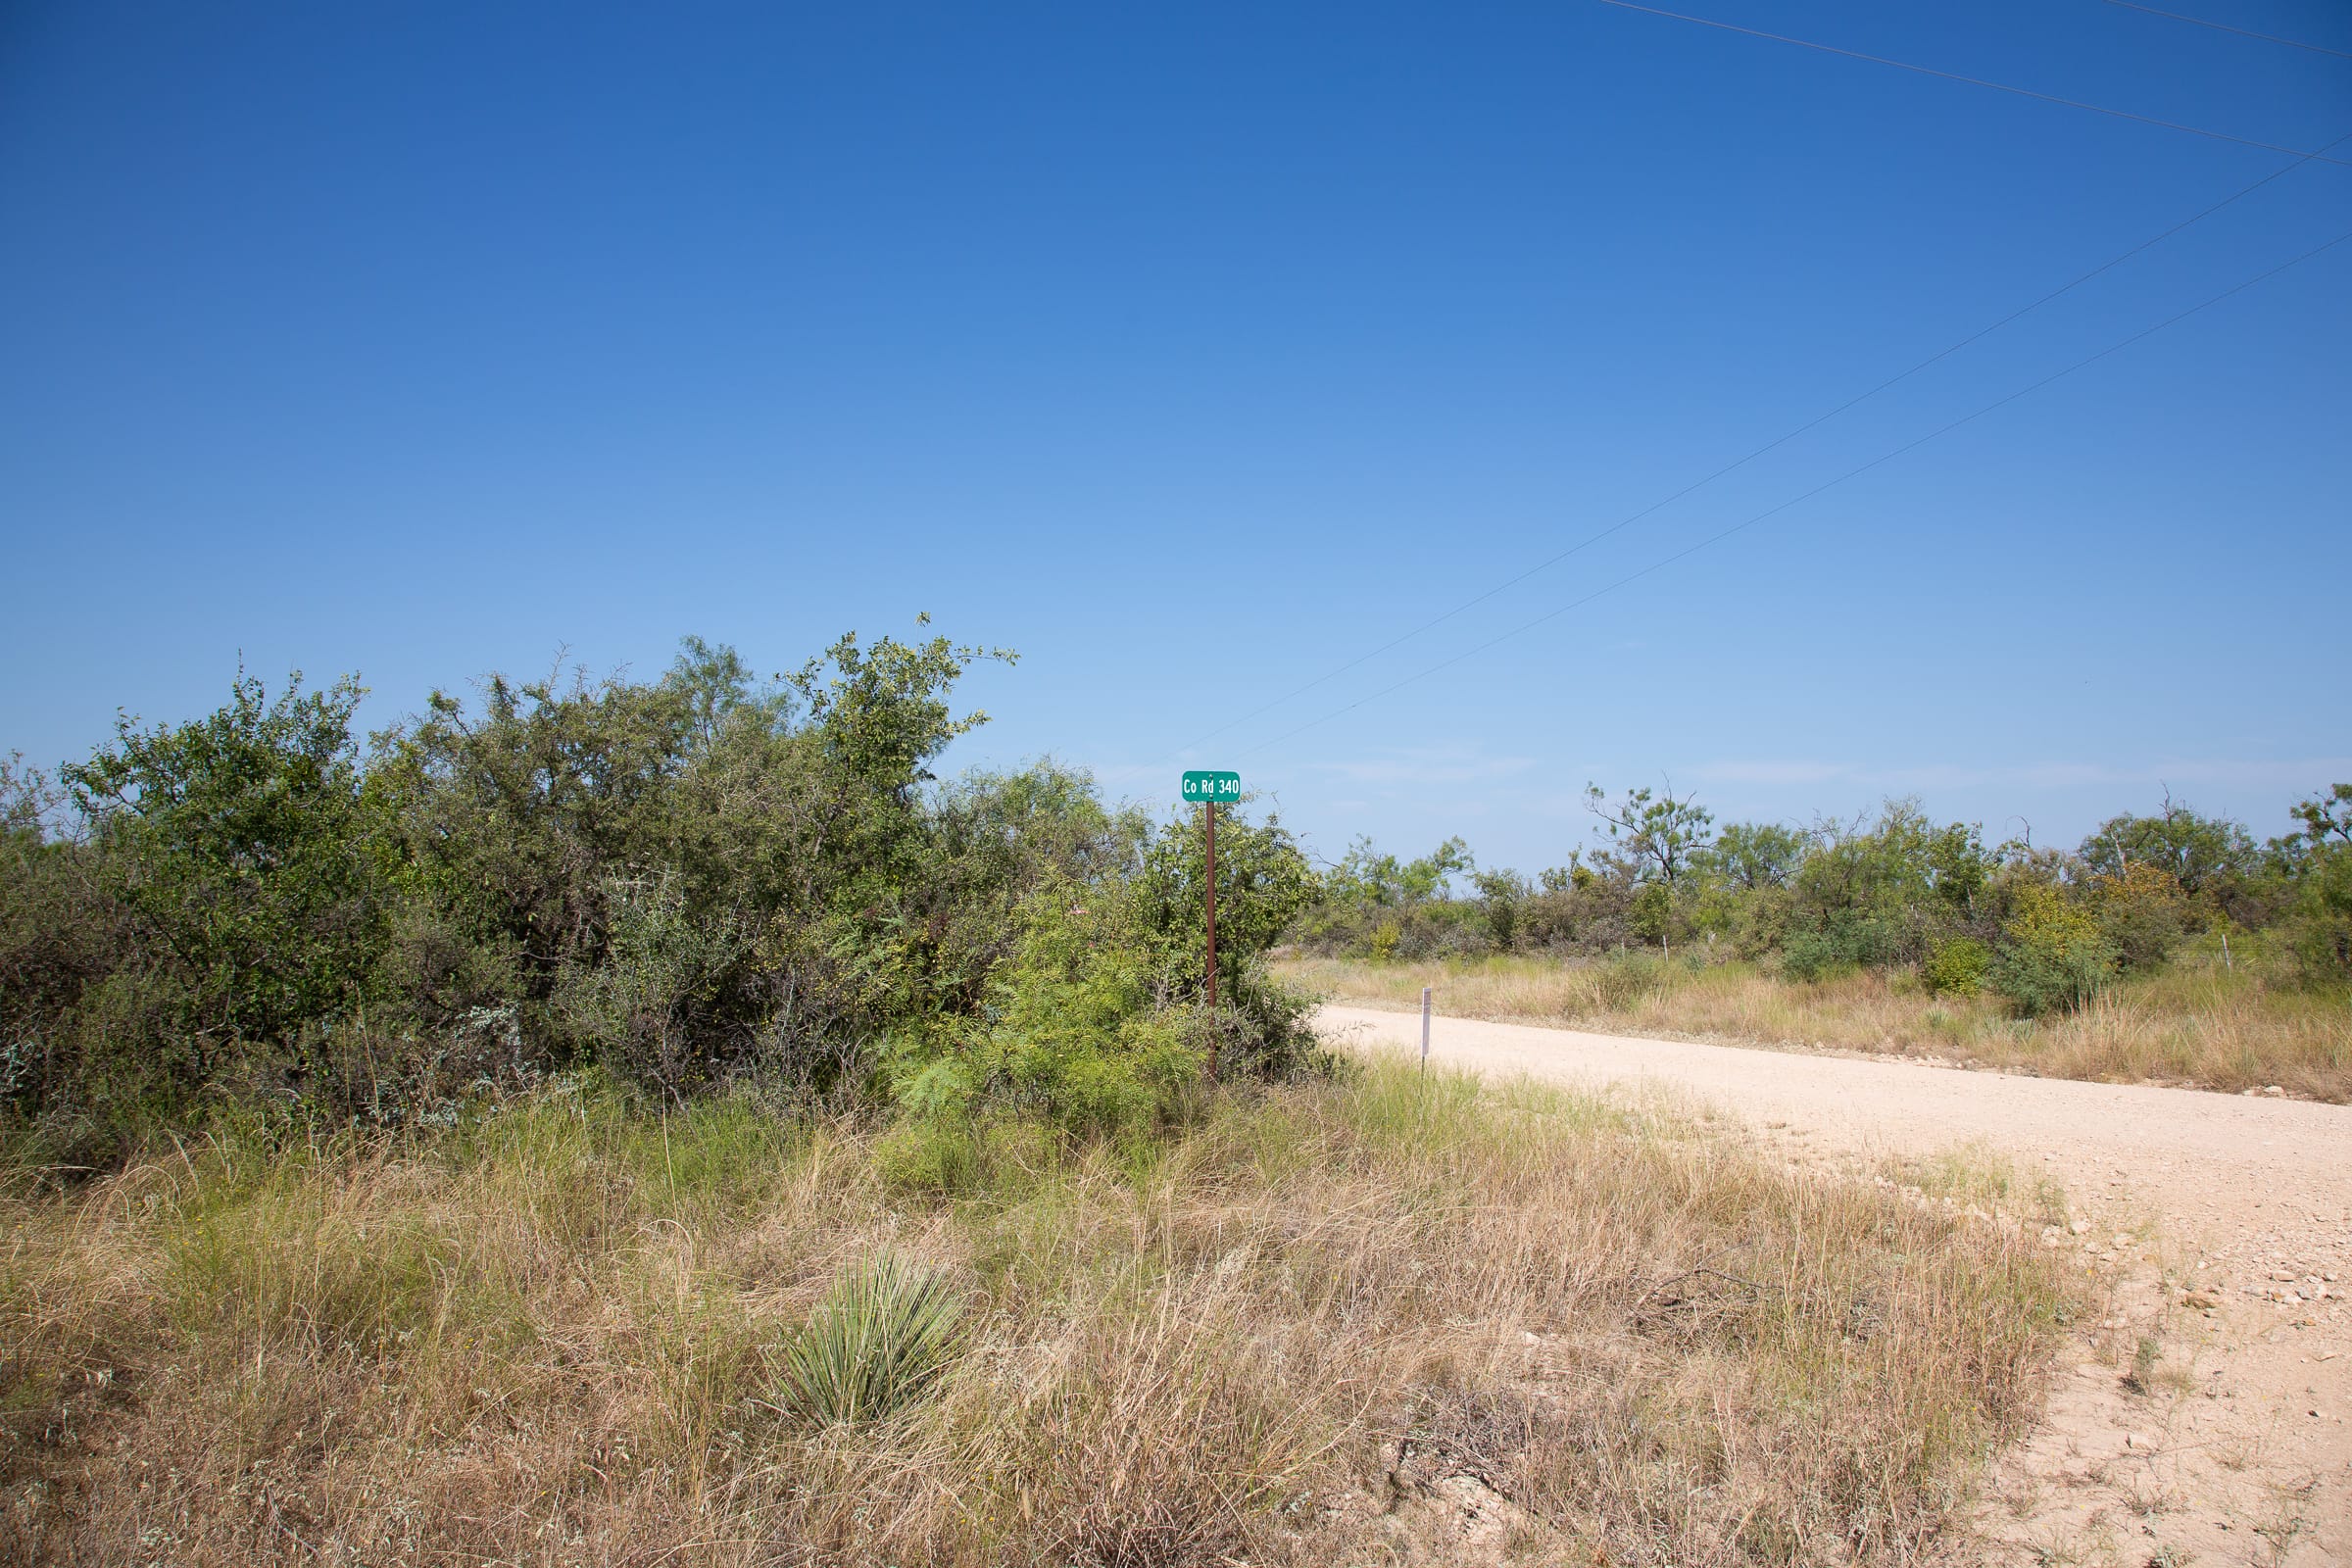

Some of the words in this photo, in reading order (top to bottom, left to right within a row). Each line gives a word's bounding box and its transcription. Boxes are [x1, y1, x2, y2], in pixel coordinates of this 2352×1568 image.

[1184, 779, 1197, 794] Co
[1201, 779, 1214, 794] Rd
[1218, 779, 1239, 794] 340
